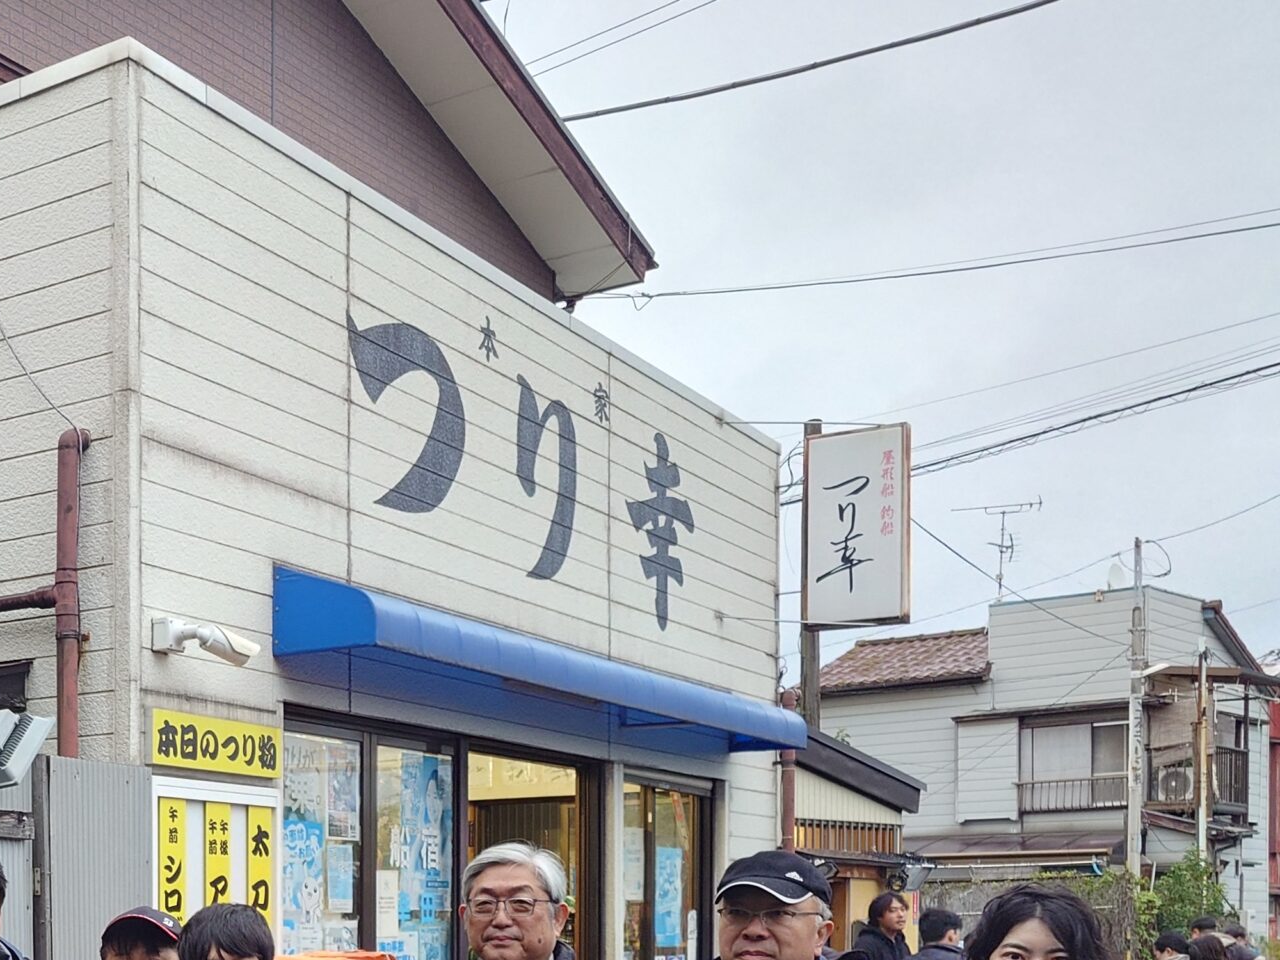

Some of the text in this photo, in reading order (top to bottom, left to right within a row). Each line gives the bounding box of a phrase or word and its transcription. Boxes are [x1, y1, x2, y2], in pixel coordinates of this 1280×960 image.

[346, 309, 695, 632] つり幸
[157, 719, 277, 771] 本日のつり物
[168, 806, 179, 844] 午前
[208, 819, 218, 855] 午前
[219, 819, 229, 856] 午後
[164, 855, 183, 922] シロ
[251, 824, 270, 912] 太刀
